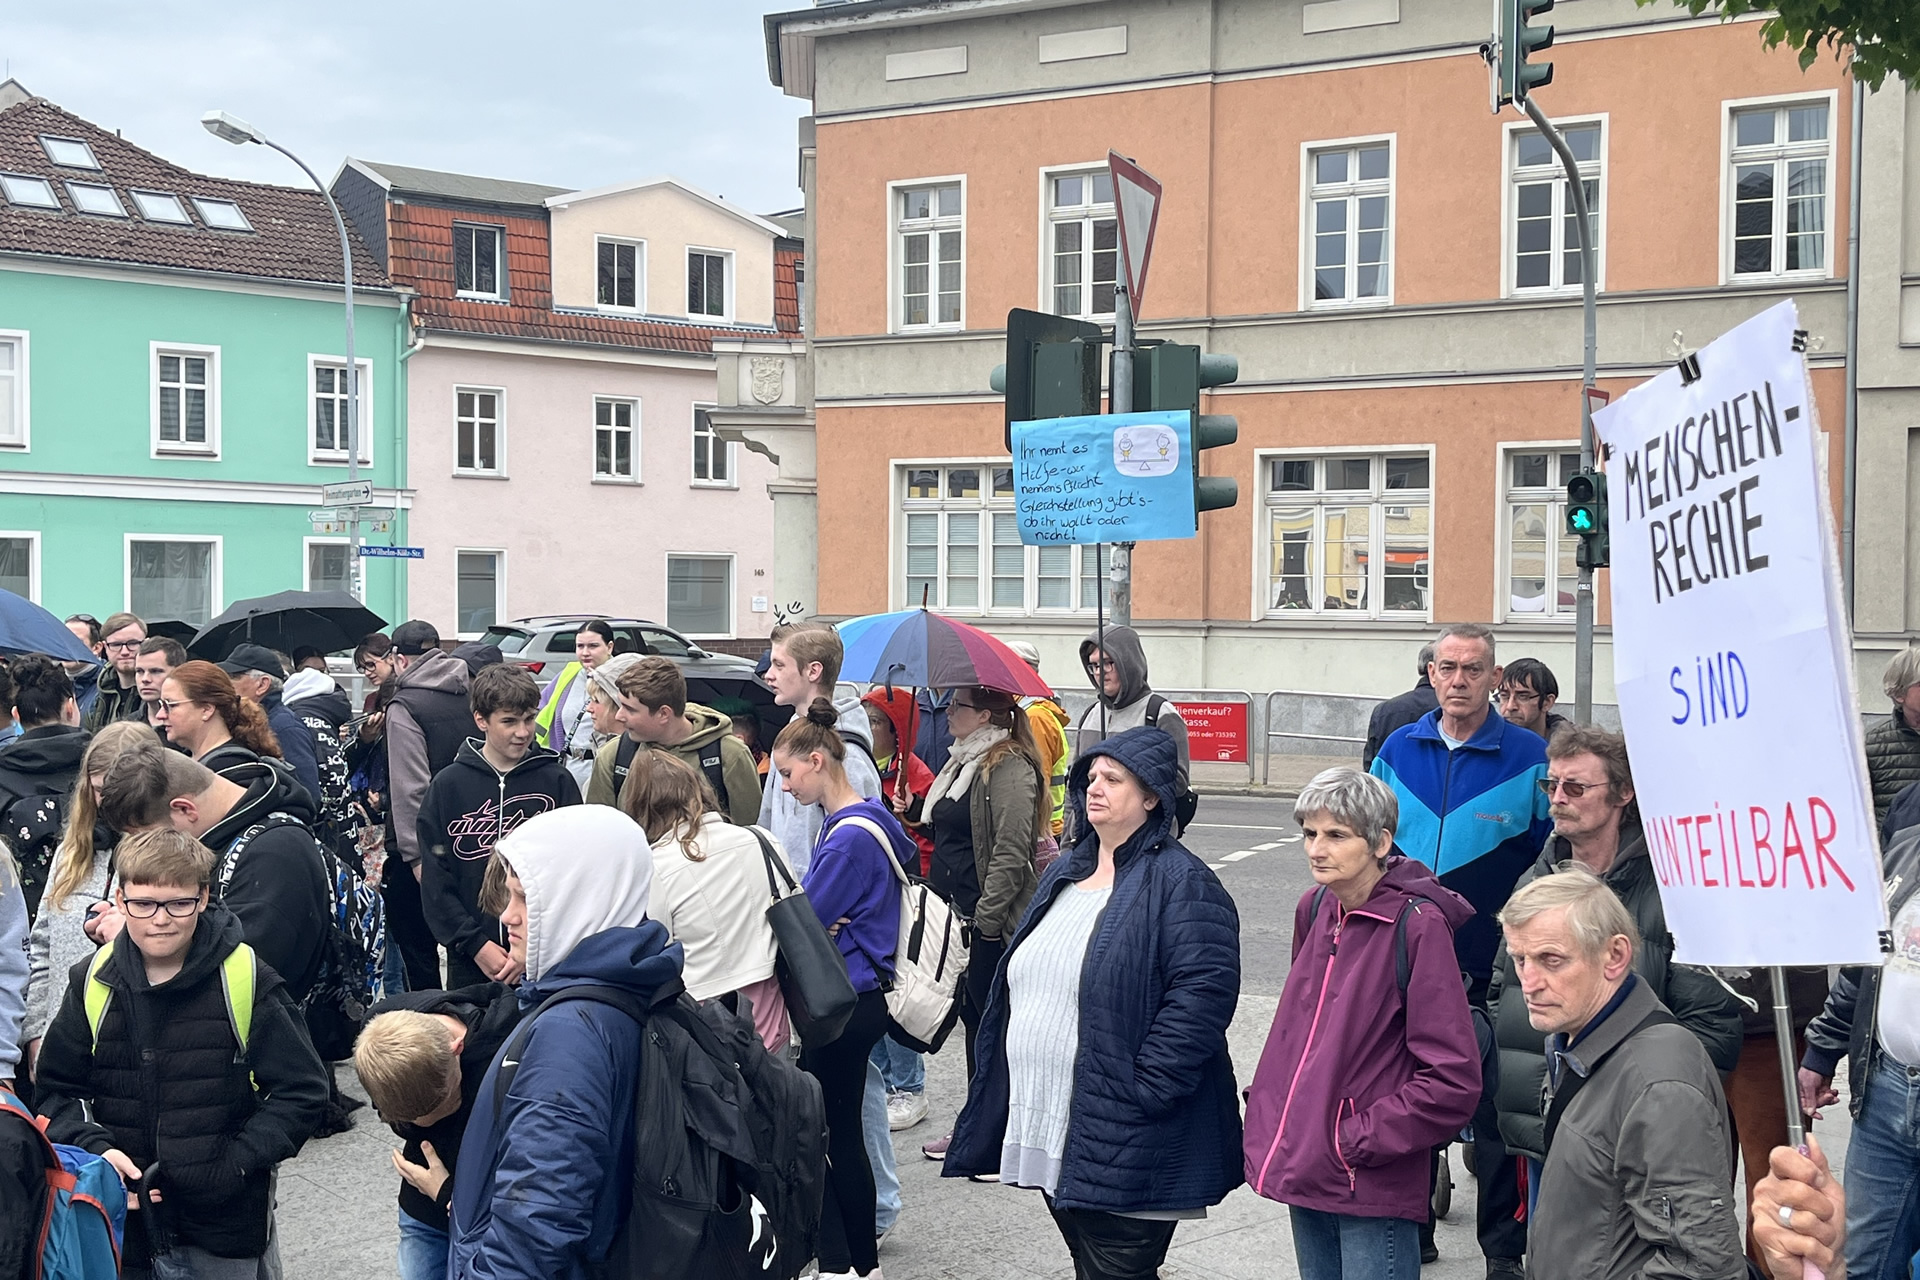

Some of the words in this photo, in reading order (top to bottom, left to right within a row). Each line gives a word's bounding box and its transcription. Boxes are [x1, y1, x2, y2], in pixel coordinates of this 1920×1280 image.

[1020, 437, 1036, 460] Ihr
[1072, 444, 1088, 454] es
[1624, 381, 1800, 524] MENSCHEN-
[1024, 516, 1038, 528] ob
[1041, 515, 1056, 527] ihr
[1097, 515, 1130, 526] oder
[1035, 528, 1076, 541] nicht!
[1649, 474, 1769, 604] RECHTE
[1183, 717, 1212, 727] kasse.
